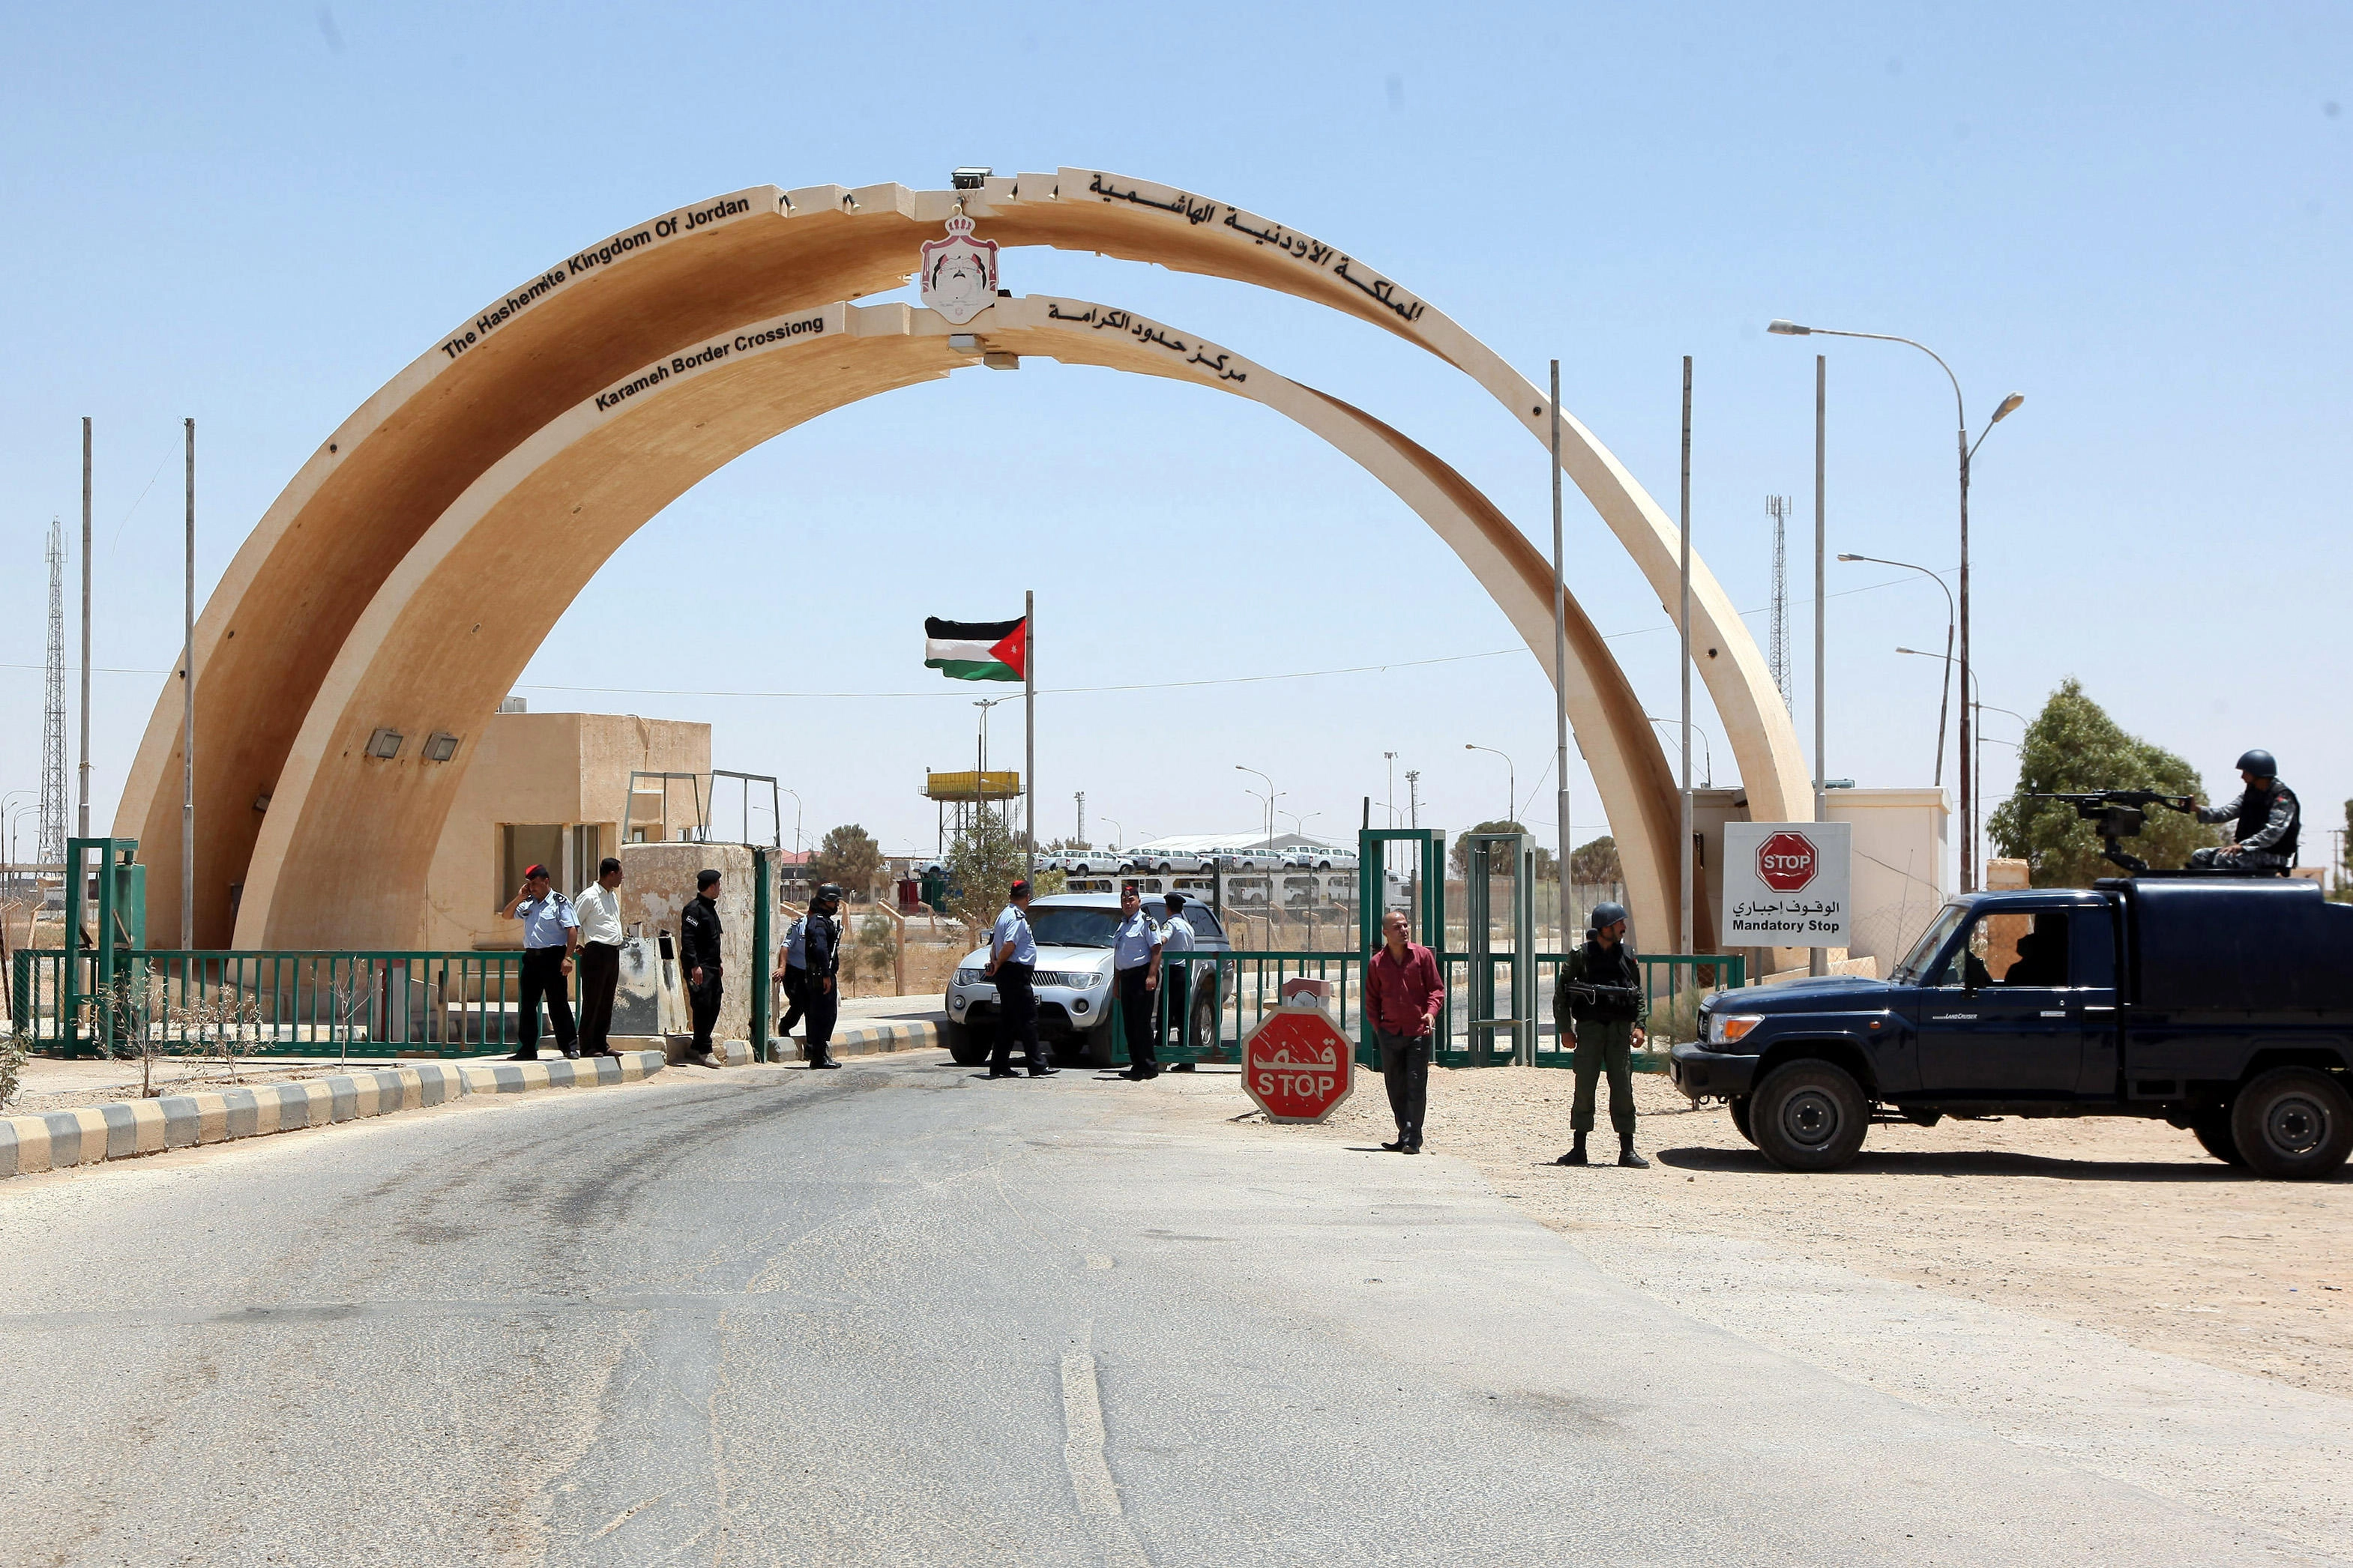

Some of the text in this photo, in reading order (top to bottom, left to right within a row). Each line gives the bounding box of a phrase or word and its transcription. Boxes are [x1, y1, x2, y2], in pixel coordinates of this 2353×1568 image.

[1089, 173, 1216, 225] الهاشمية
[442, 197, 750, 359] The Hashemite Kingdom Of Jordan
[1048, 304, 1247, 383] مركز حدود الكرامة
[594, 316, 824, 411] Karameh Border Crossiong
[1764, 855, 1810, 869] STOP
[1732, 900, 1840, 917] الوقوف إجباري
[1732, 920, 1840, 933] Mandatory Stop
[1253, 1038, 1337, 1072] قف
[1257, 1073, 1335, 1098] STOP
